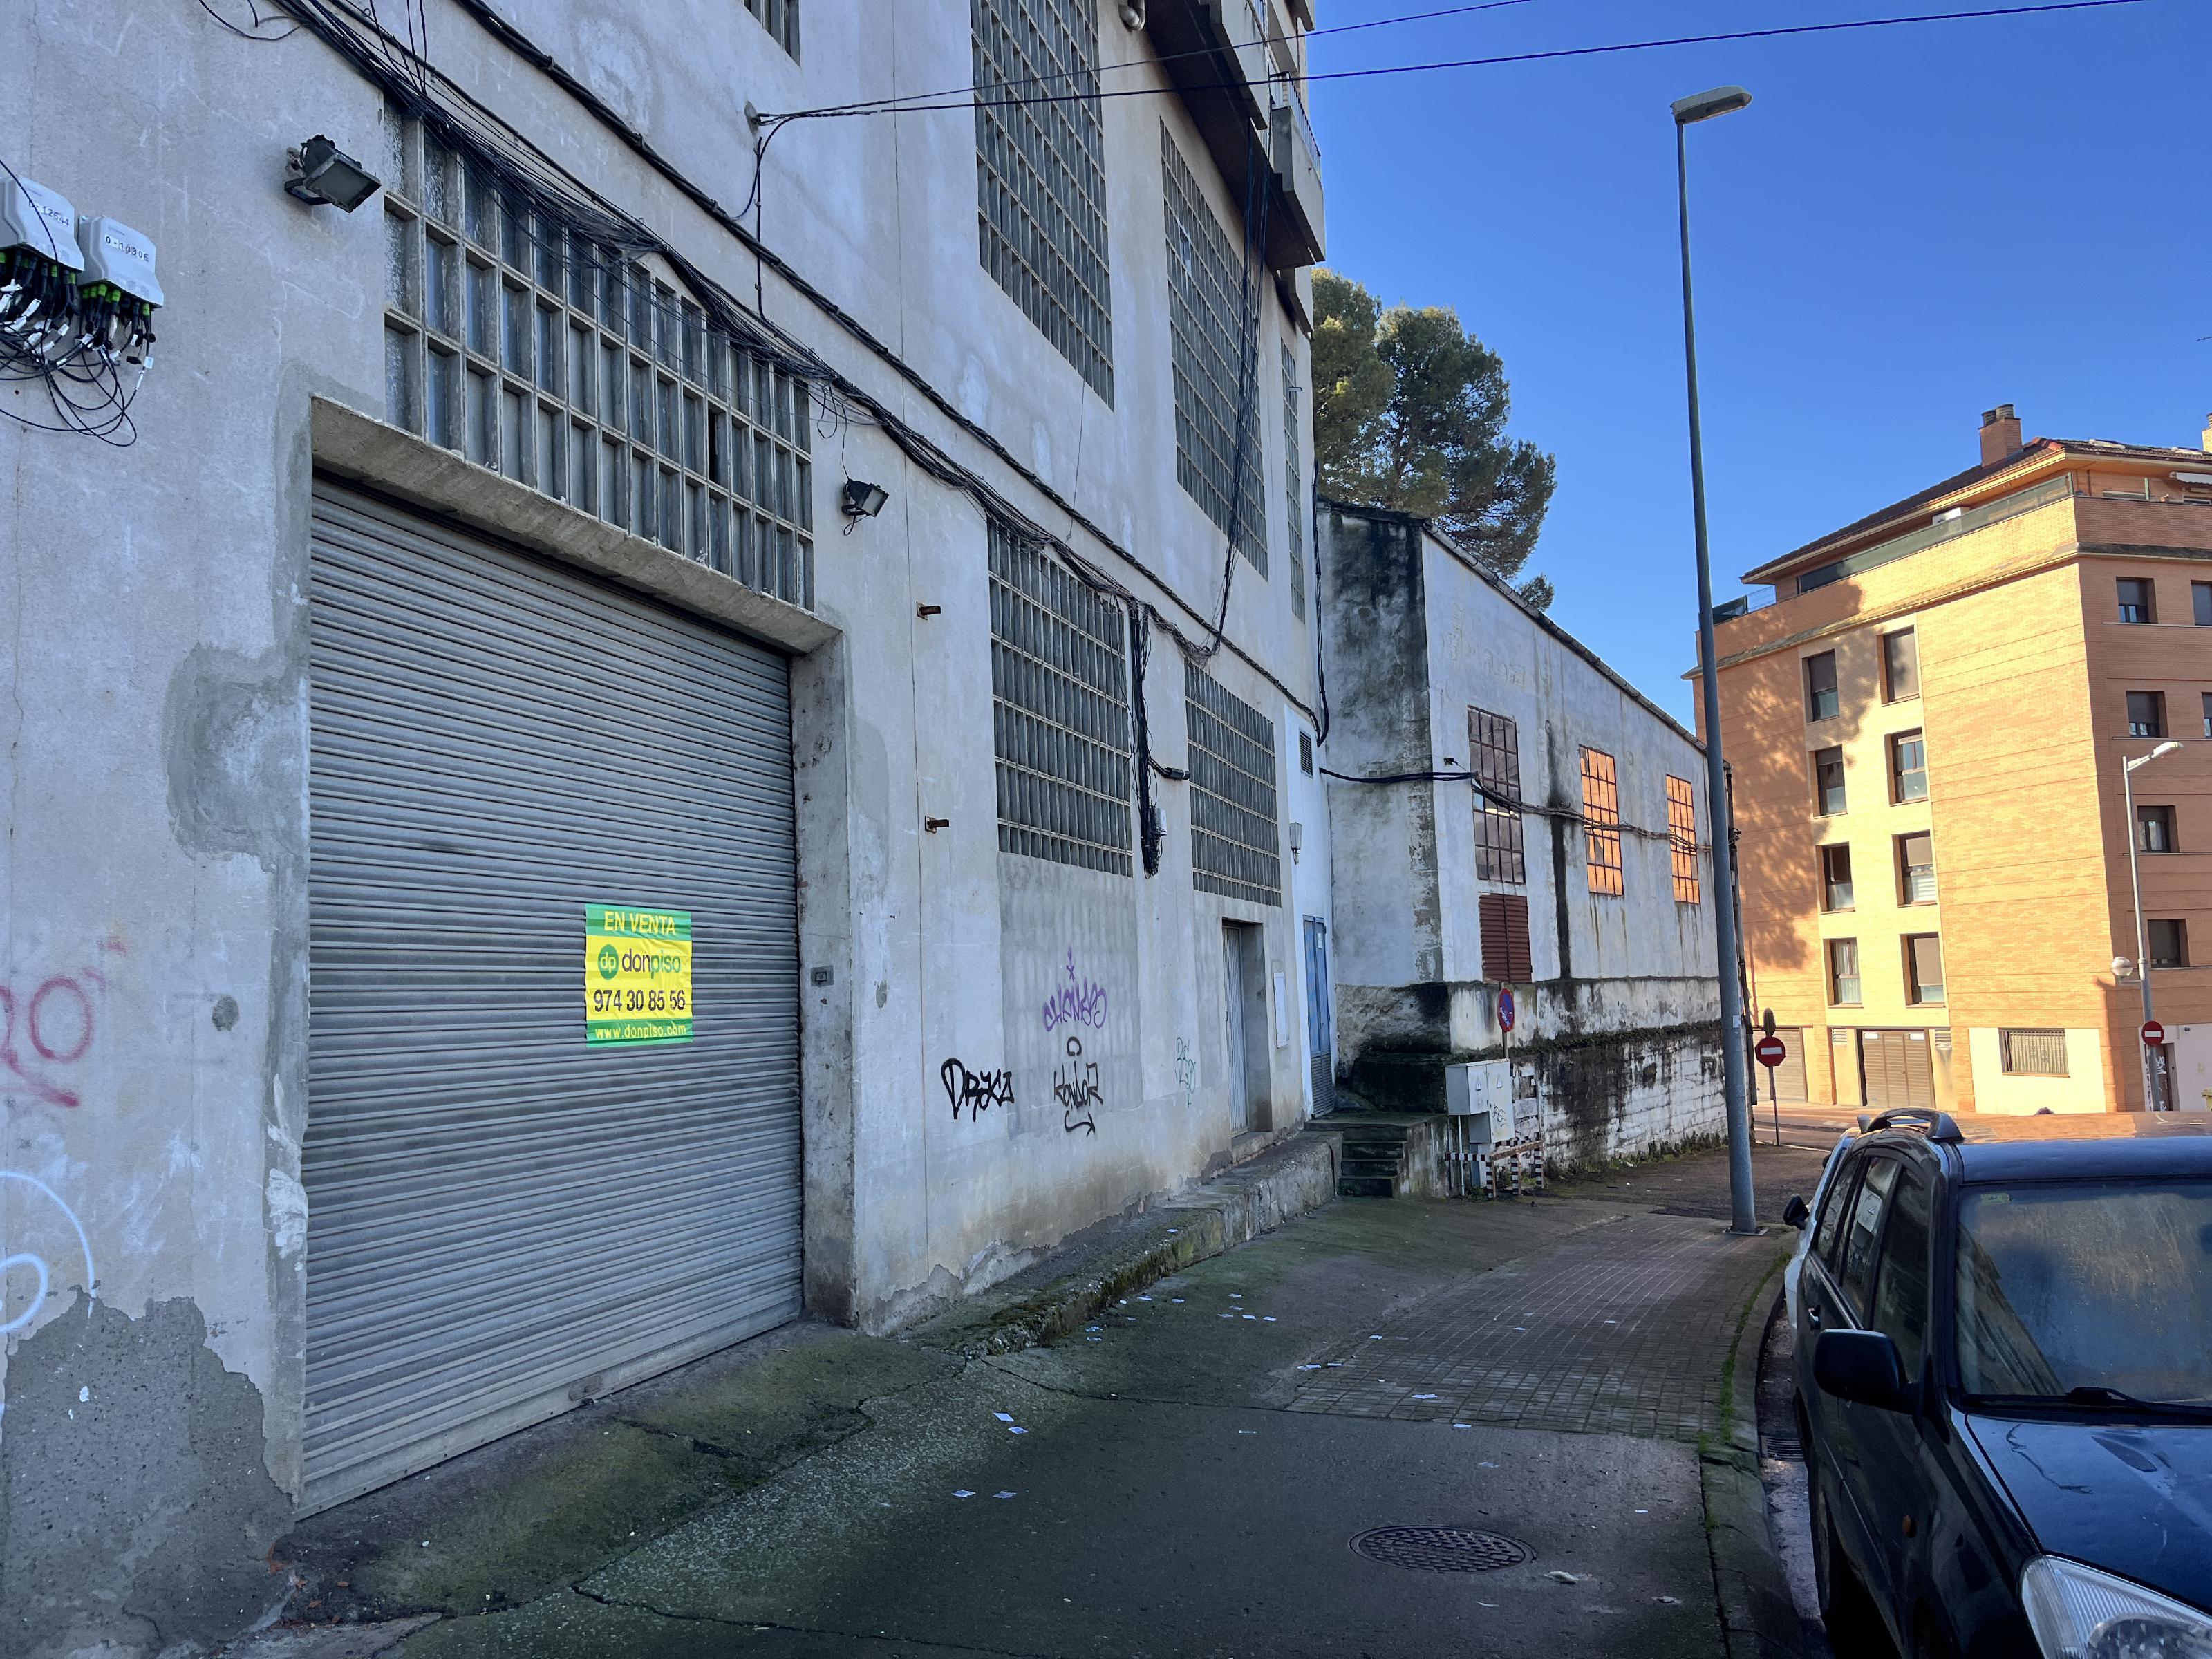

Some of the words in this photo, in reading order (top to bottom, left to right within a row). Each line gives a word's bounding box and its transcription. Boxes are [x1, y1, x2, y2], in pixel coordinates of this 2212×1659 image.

[604, 911, 625, 932] EN
[630, 913, 676, 935] VENTA
[622, 949, 682, 979] donpiso
[594, 989, 623, 1012] 974
[626, 990, 644, 1011] 30
[648, 989, 665, 1011] 85
[669, 989, 686, 1011] 56
[595, 1024, 686, 1040] www.donpiso.com
